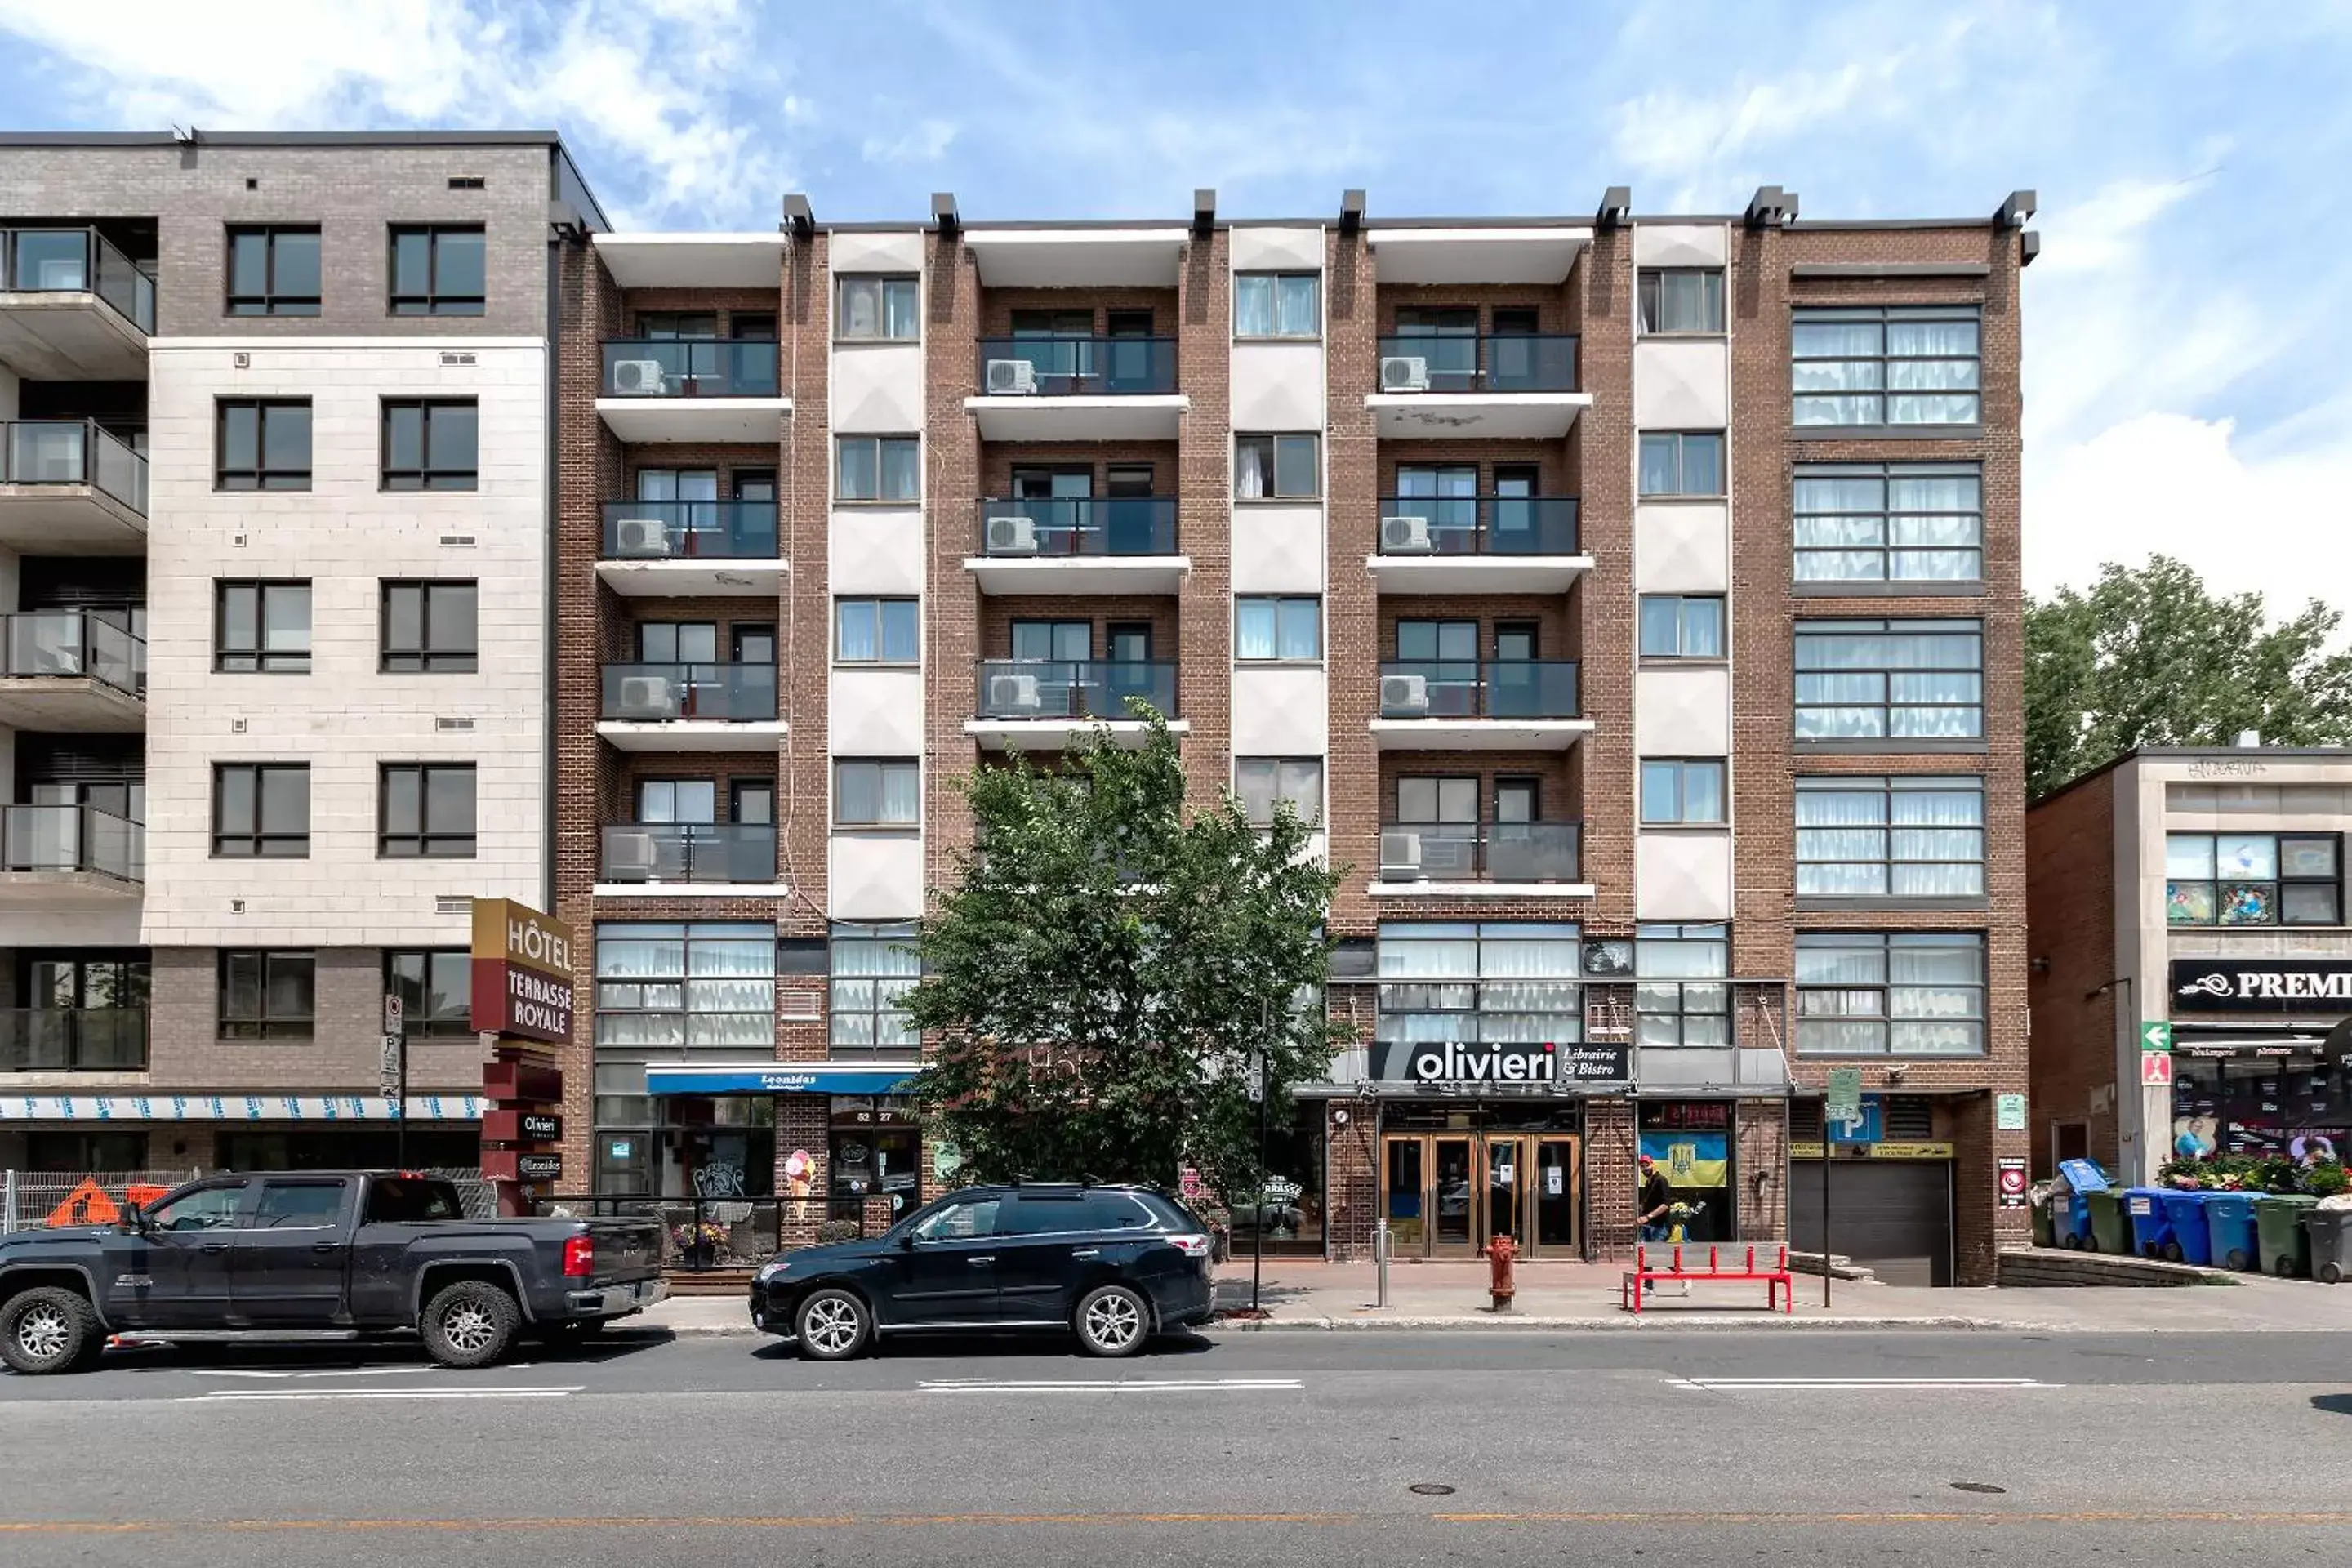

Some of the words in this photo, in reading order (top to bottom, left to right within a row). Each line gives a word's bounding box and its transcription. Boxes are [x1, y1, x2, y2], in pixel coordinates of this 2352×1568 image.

[508, 917, 572, 971] HÔTEL
[508, 970, 572, 1010] TERRASSE
[2237, 973, 2352, 998] PREMI
[515, 1000, 566, 1034] ROYALE
[1416, 1042, 1556, 1080] olivieri
[1563, 1048, 1617, 1060] Librairie
[1563, 1062, 1577, 1075] &
[1577, 1062, 1615, 1075] Bistro
[761, 1074, 816, 1084] Leonidas
[524, 1116, 555, 1132] Olivieri
[879, 1112, 893, 1122] 27
